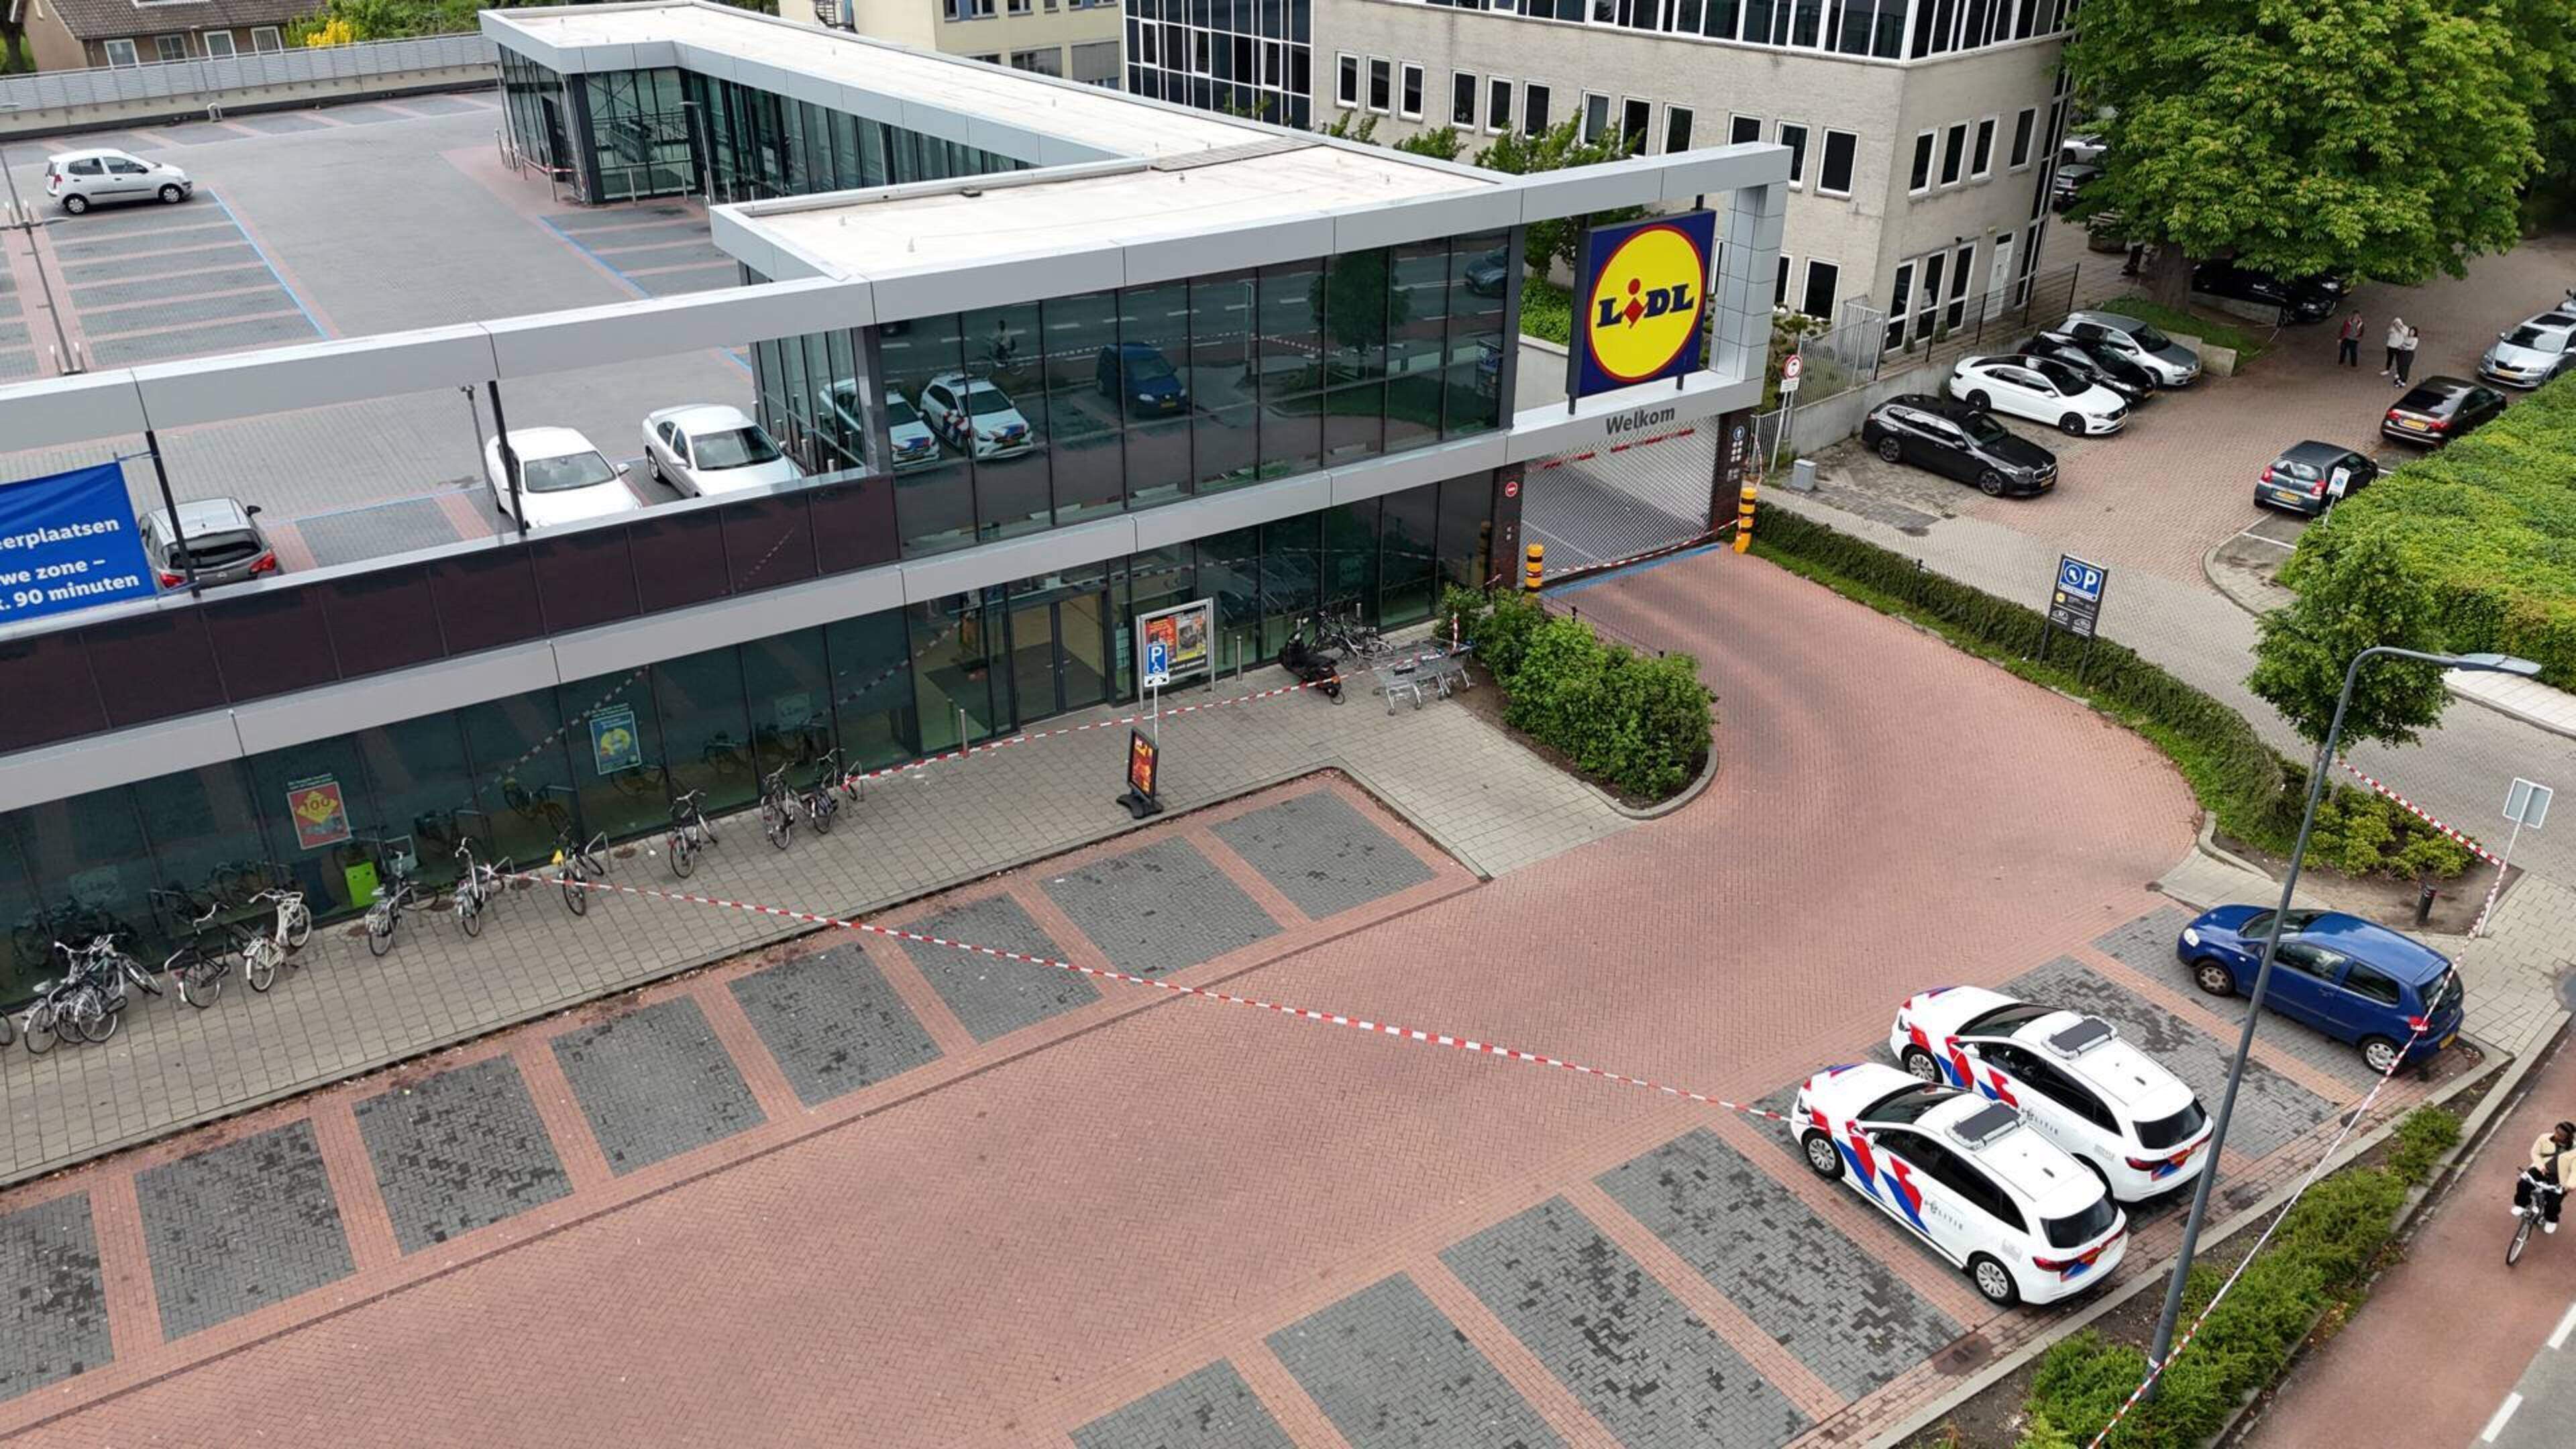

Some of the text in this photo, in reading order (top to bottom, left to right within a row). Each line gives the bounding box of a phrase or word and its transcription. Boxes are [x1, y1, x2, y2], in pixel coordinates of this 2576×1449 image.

[1606, 405, 1675, 435] Welkom
[0, 519, 119, 549] erplaatsen
[0, 571, 31, 586] we
[36, 560, 88, 579] zone
[2084, 570, 2097, 589] P
[13, 588, 44, 607] 90
[48, 575, 139, 601] minuten
[1151, 647, 1162, 663] P
